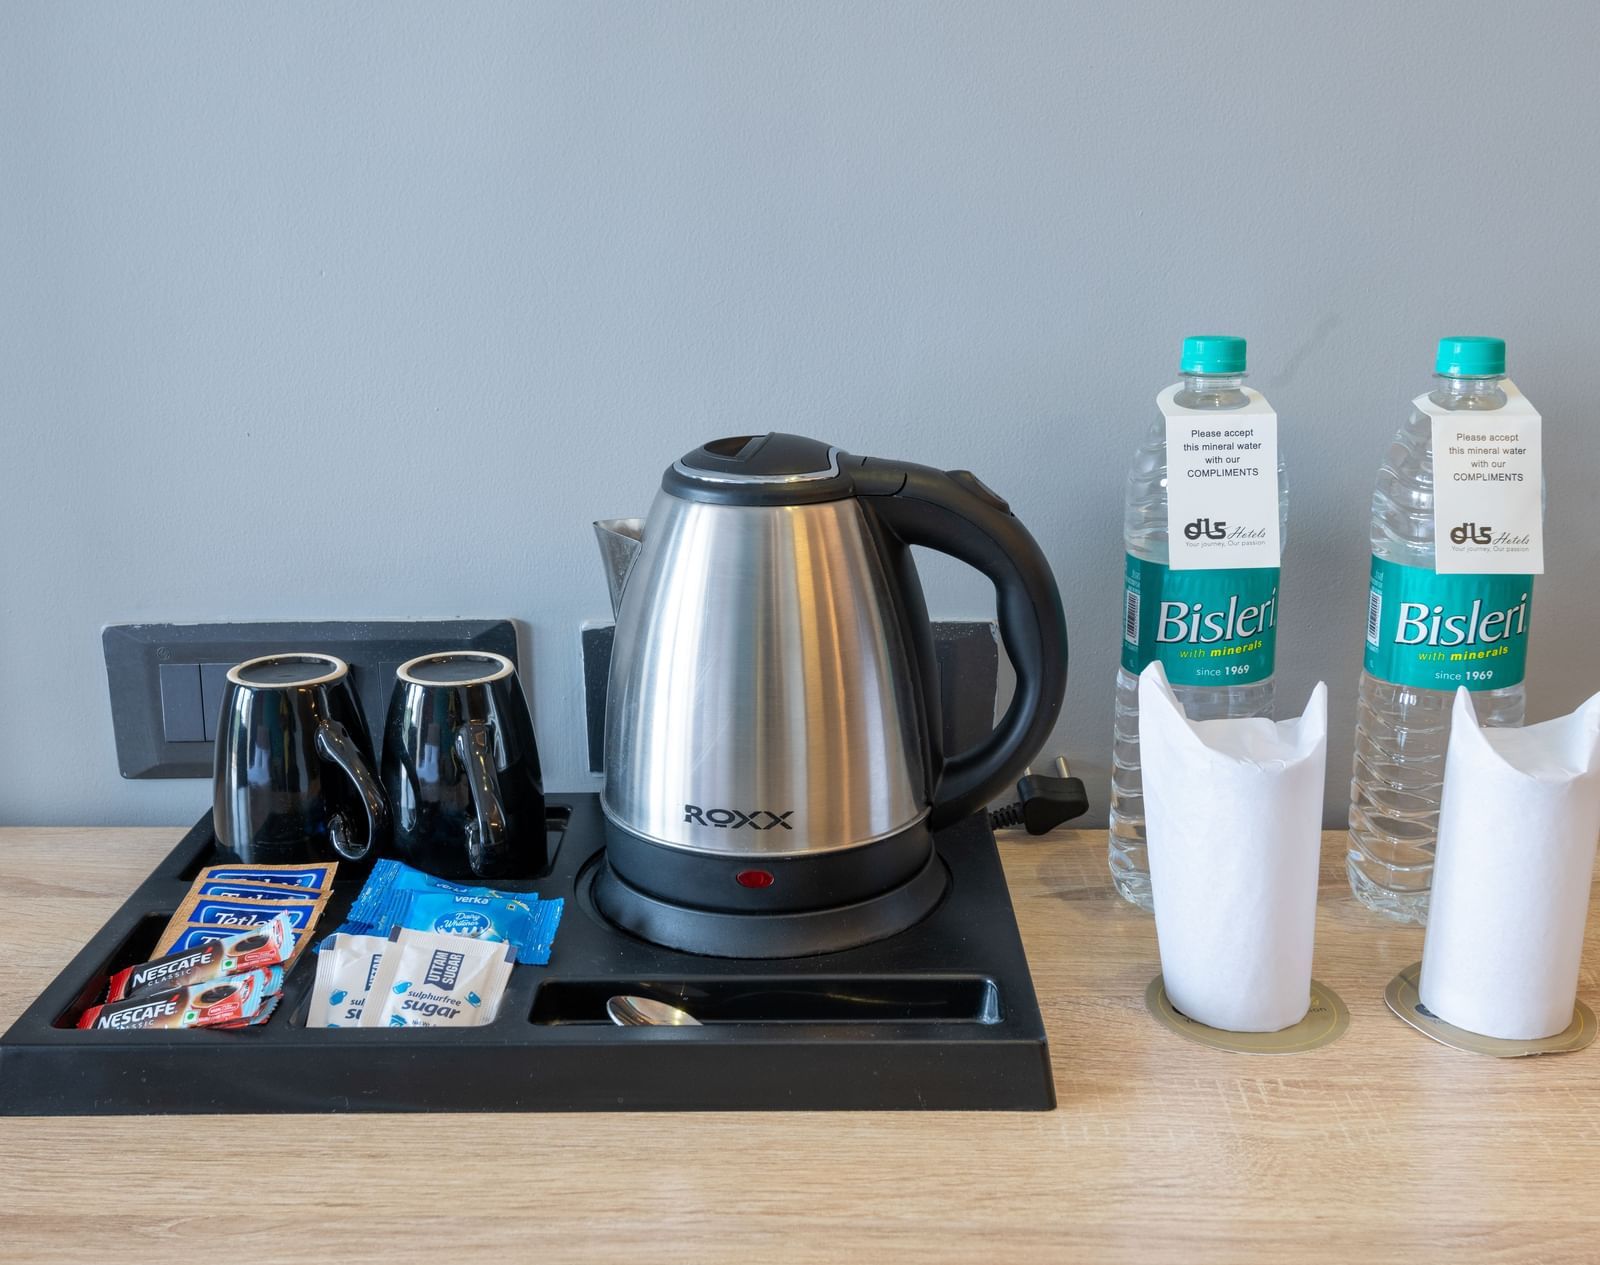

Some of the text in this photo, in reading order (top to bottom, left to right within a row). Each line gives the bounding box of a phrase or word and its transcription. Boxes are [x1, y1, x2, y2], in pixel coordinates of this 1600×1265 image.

[1191, 429, 1254, 438] Please accept
[1456, 433, 1519, 442] Please accept
[1183, 442, 1262, 452] this mineral water
[1449, 446, 1527, 455] this mineral water
[1205, 456, 1240, 464] with our
[1471, 460, 1489, 468] with
[1187, 467, 1259, 478] COMPLIMENTS
[1453, 472, 1524, 482] COMPLIMENTS
[1227, 525, 1266, 540] Hotels
[1492, 531, 1530, 545] Hotels
[1241, 540, 1266, 548] passion
[1155, 586, 1277, 645] Bisleri
[1394, 592, 1528, 647] Bisleri
[1179, 639, 1263, 659] with minerals
[1418, 645, 1509, 662] with minerals
[1196, 665, 1250, 677] since 1969
[1434, 670, 1494, 681] since 1969
[683, 804, 794, 830] ROXX
[455, 895, 489, 905] verka
[215, 912, 272, 925] Tetle
[427, 951, 449, 982] UTTAM
[441, 953, 463, 985] SUGAR
[147, 968, 192, 987] CLASSIC
[407, 990, 462, 1006] sulphurfree
[401, 999, 461, 1019] sugar
